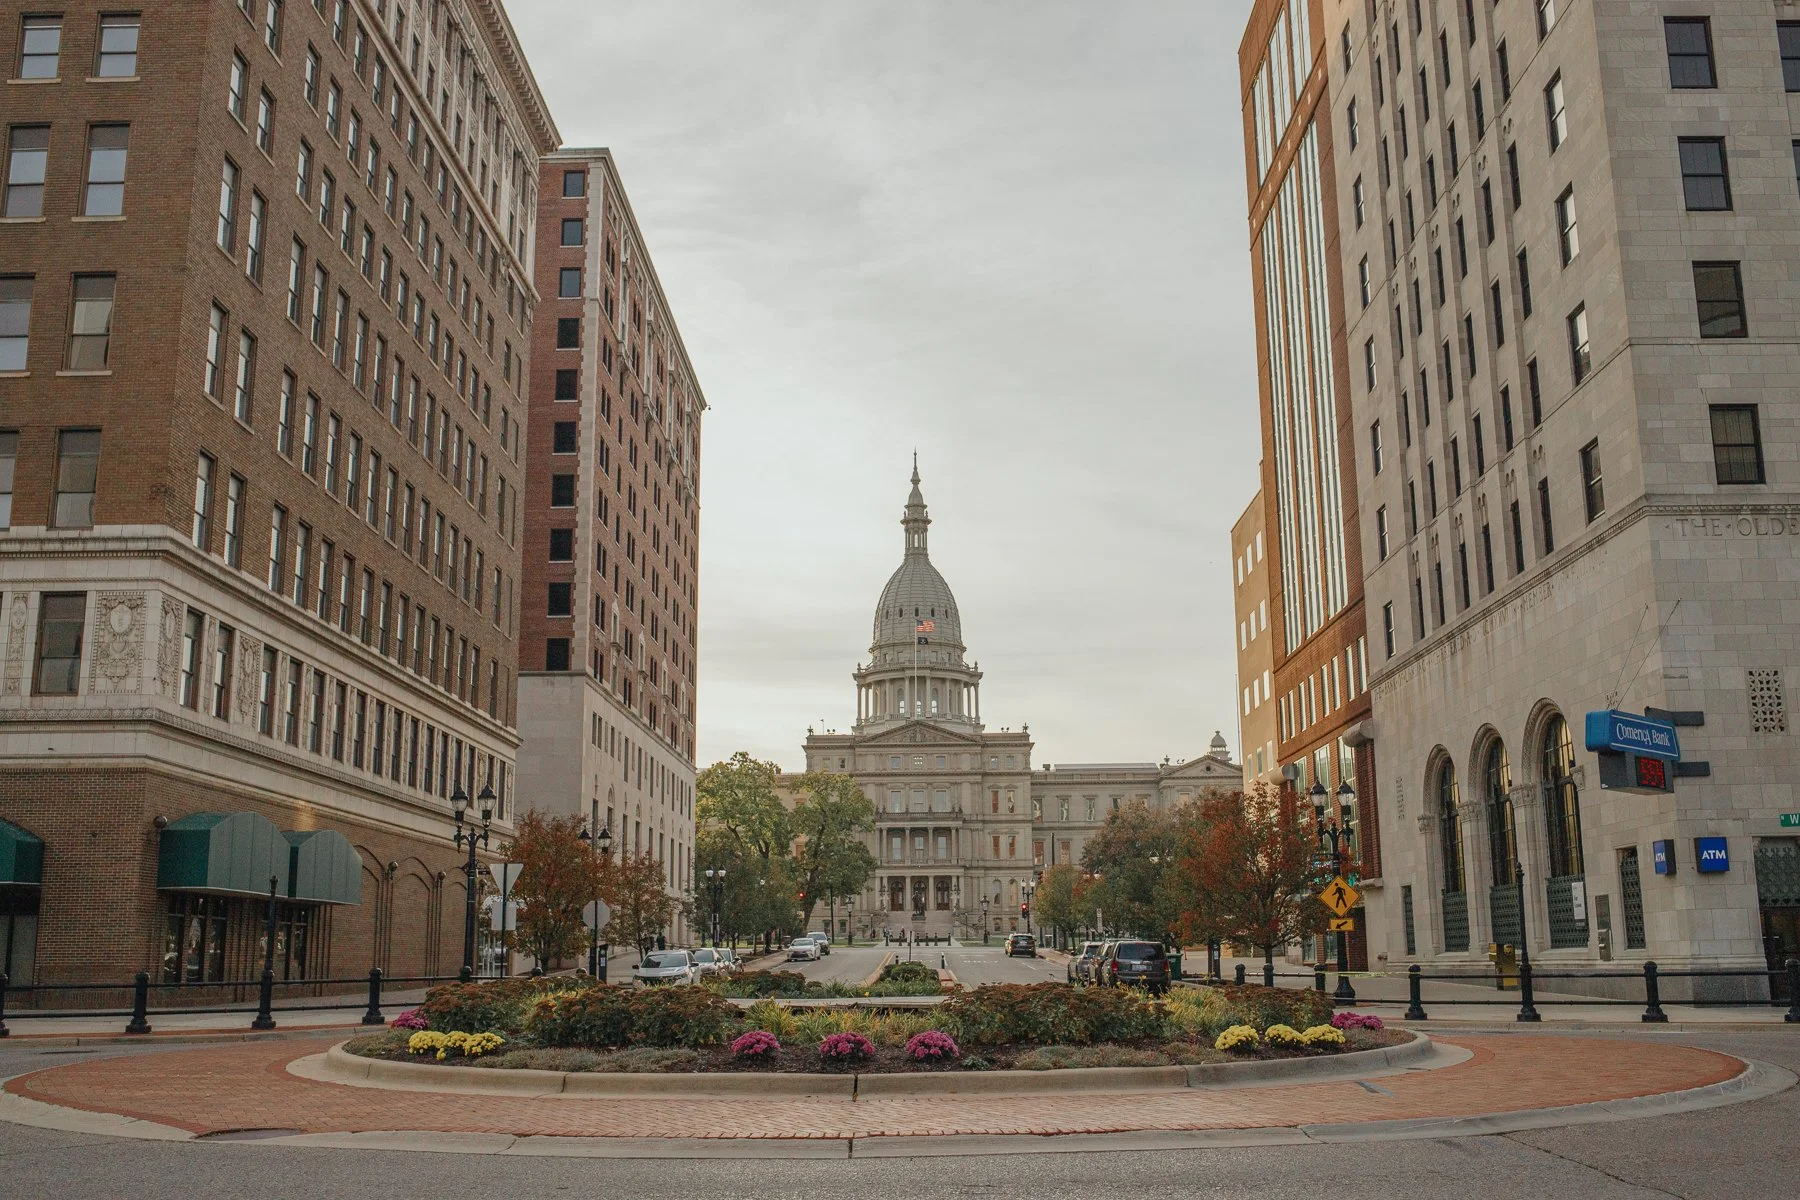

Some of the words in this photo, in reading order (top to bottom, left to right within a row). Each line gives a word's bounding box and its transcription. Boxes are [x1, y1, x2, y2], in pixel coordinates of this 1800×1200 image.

[1675, 518, 1723, 537] THE
[1652, 729, 1671, 747] Bank
[1655, 852, 1666, 862] ATM
[1701, 849, 1727, 860] ATM
